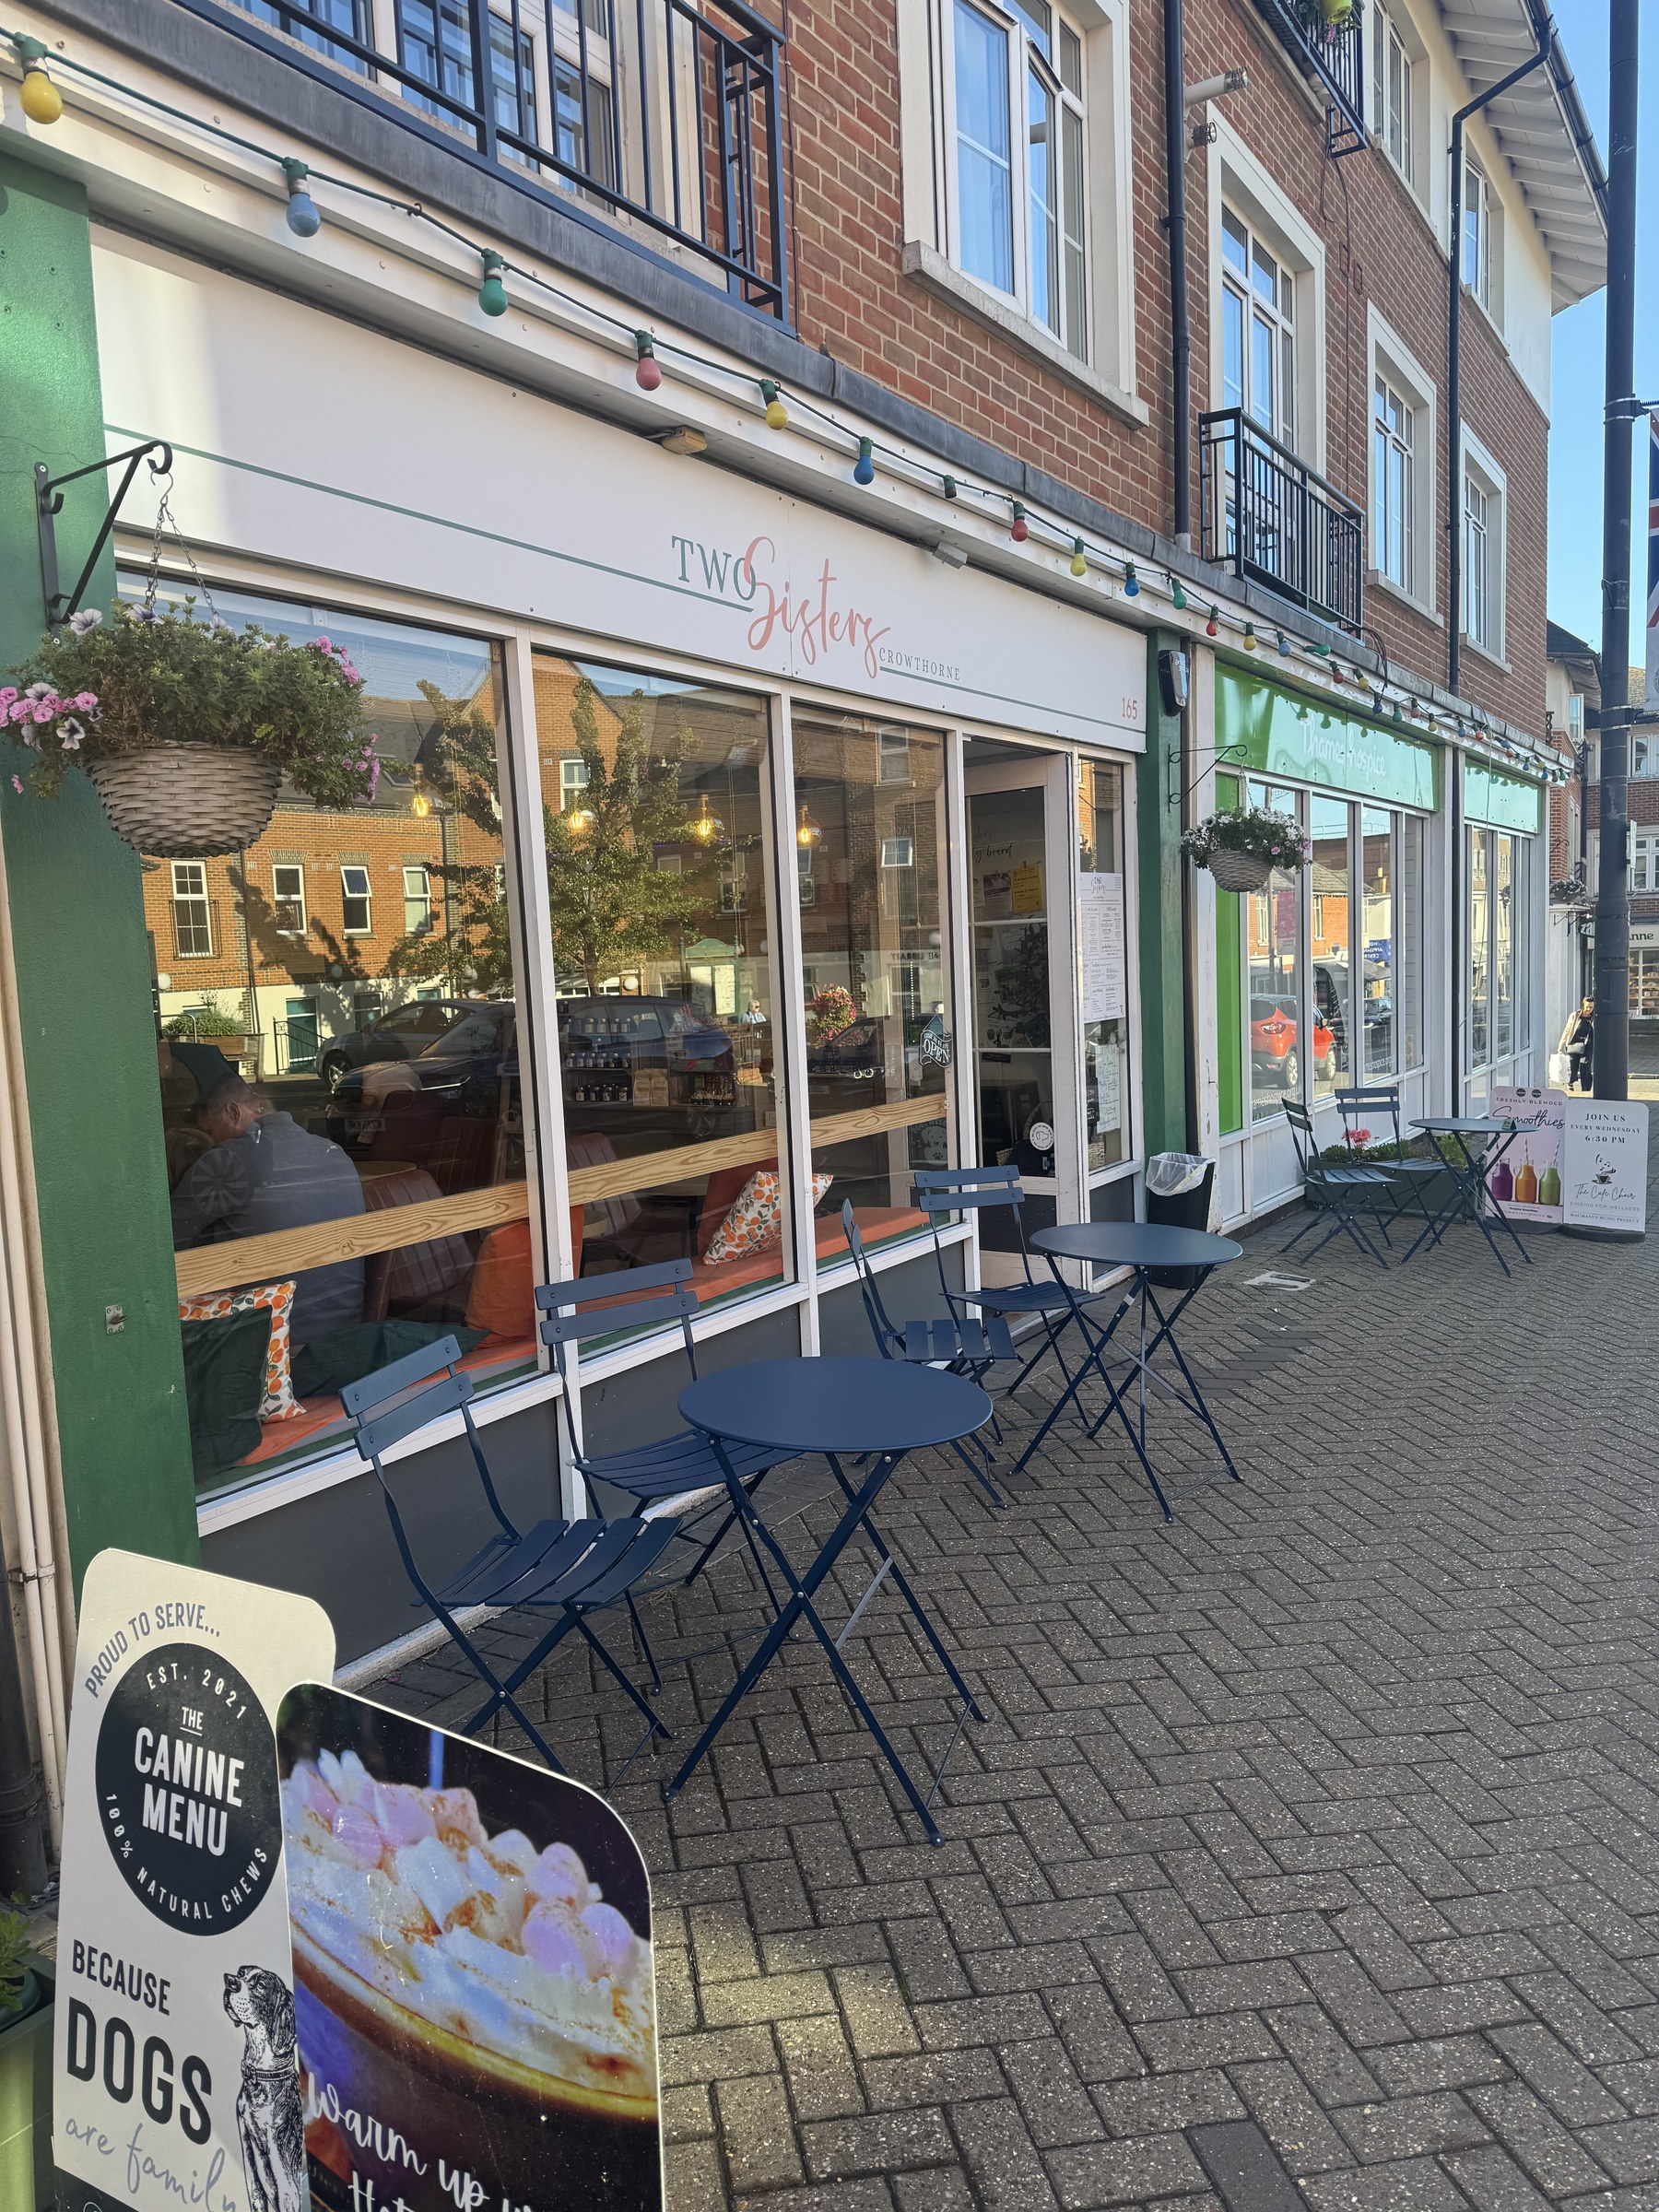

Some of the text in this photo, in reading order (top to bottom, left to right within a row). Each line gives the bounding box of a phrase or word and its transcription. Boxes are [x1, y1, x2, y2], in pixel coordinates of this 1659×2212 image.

[671, 535, 891, 679] TWO Sisters
[878, 647, 960, 681] CROWTHORNE
[1121, 697, 1139, 721] 165
[1347, 726, 1387, 782] hospice
[924, 1039, 950, 1063] OPEN
[1492, 1105, 1565, 1130] Smoothies
[1595, 1125, 1641, 1134] WEDNESDAY
[1574, 1182, 1589, 1199] The
[85, 1602, 221, 1700] PROUD TO SERVE...
[147, 1663, 247, 1720] EST. 2021
[182, 1706, 204, 1730] THE
[134, 1726, 244, 1807] CANINE
[142, 1783, 228, 1856] MENU
[106, 1794, 267, 1920] 100% NATURAL CHEWS
[72, 1938, 171, 2016] BECAUSE
[66, 1995, 212, 2146] DOGS
[65, 2118, 115, 2155] are
[307, 2071, 428, 2176] Warm
[439, 2159, 490, 2212] up
